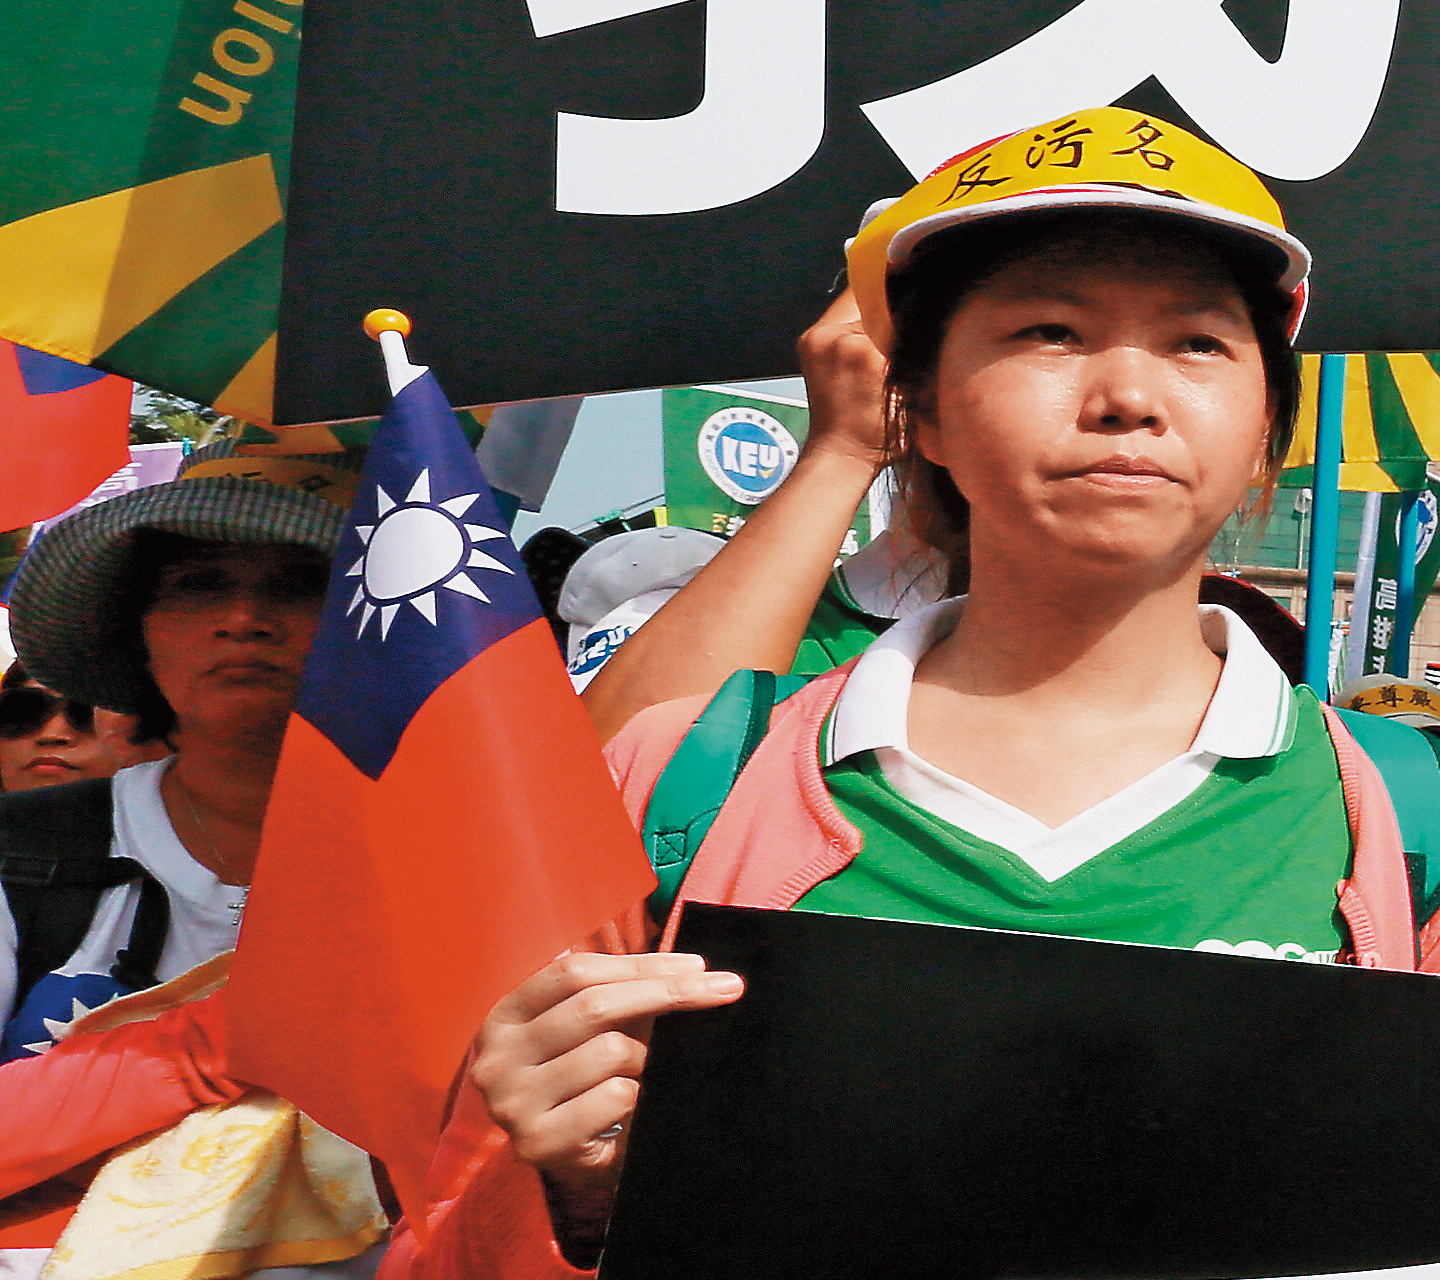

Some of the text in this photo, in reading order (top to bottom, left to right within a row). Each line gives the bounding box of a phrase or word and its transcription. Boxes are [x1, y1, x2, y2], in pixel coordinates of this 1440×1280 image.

[936, 118, 1176, 207] 反污名
[722, 435, 780, 477] KEU
